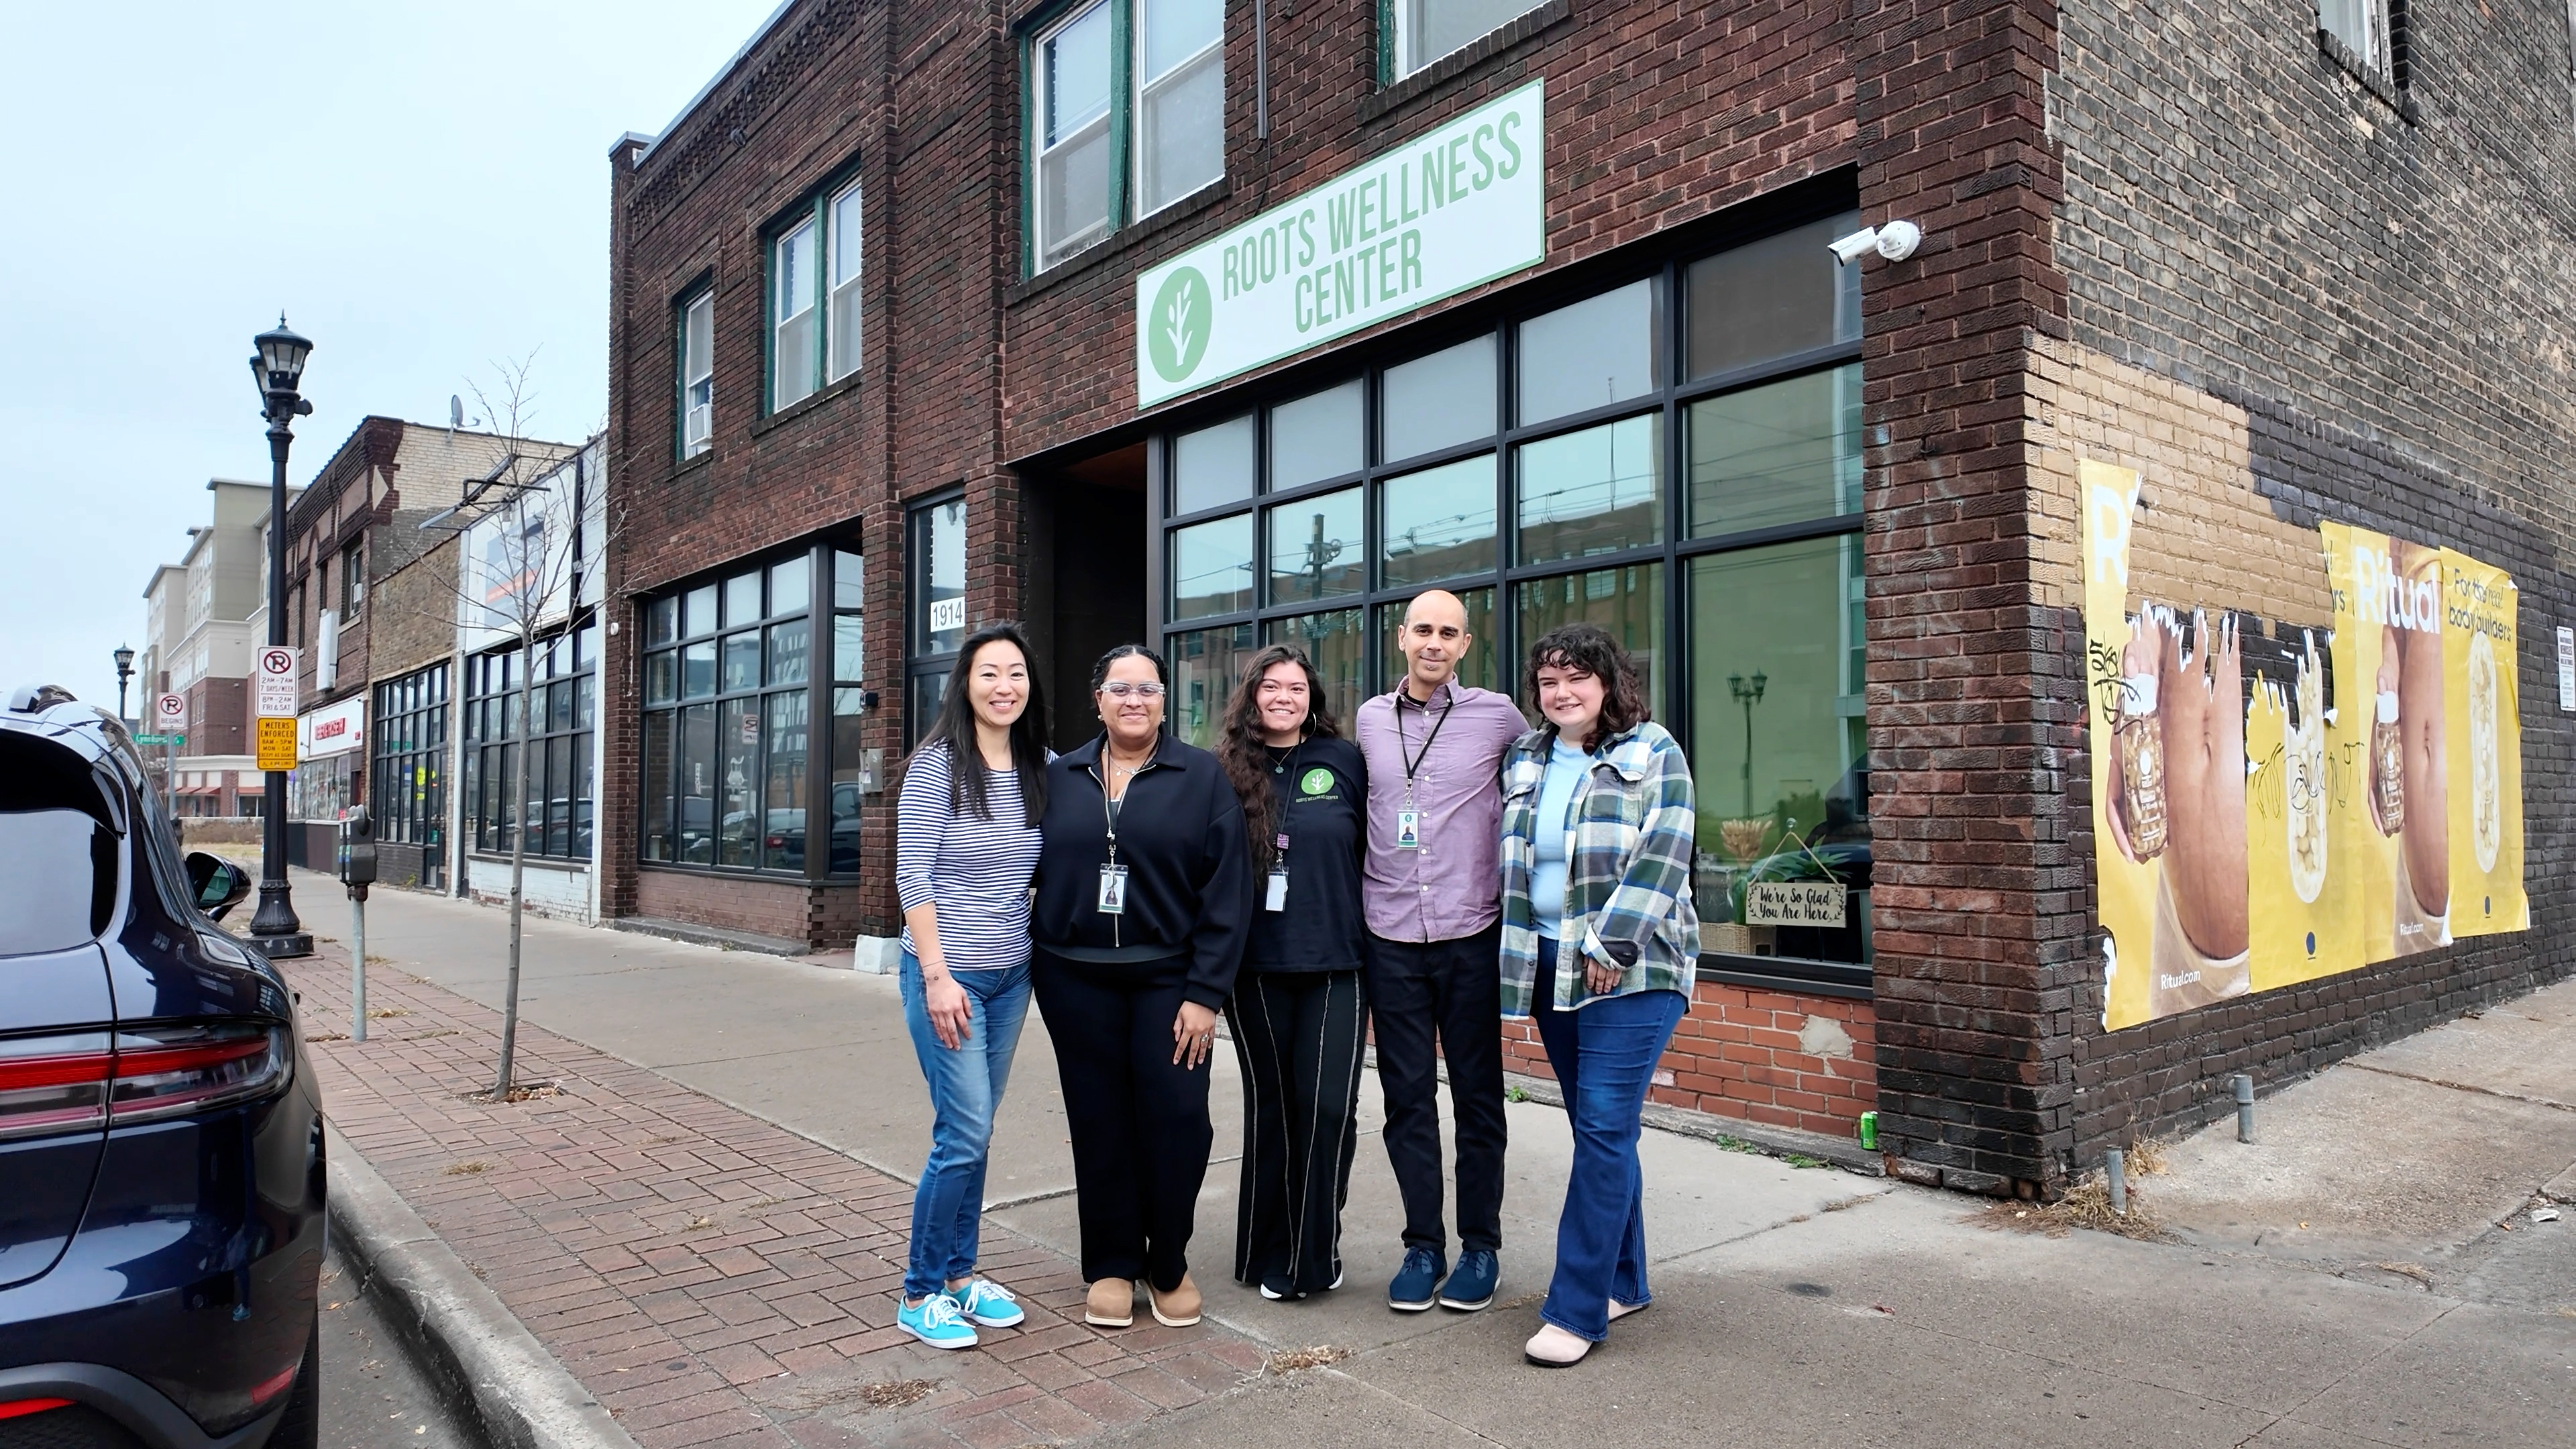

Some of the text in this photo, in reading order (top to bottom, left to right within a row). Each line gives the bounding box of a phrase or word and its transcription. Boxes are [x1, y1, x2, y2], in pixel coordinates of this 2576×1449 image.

[1223, 111, 1521, 302] ROOTS WELLNESS
[1295, 228, 1423, 333] CENTER
[2355, 545, 2440, 635] Ritual
[2455, 568, 2471, 598] For
[2488, 586, 2504, 609] real
[933, 601, 963, 627] 1914
[2449, 597, 2512, 643] body builders
[1760, 887, 1833, 906] We're So Glad
[1760, 903, 1779, 919] You
[1782, 904, 1801, 920] Are
[2161, 969, 2201, 990] Ritual.com
